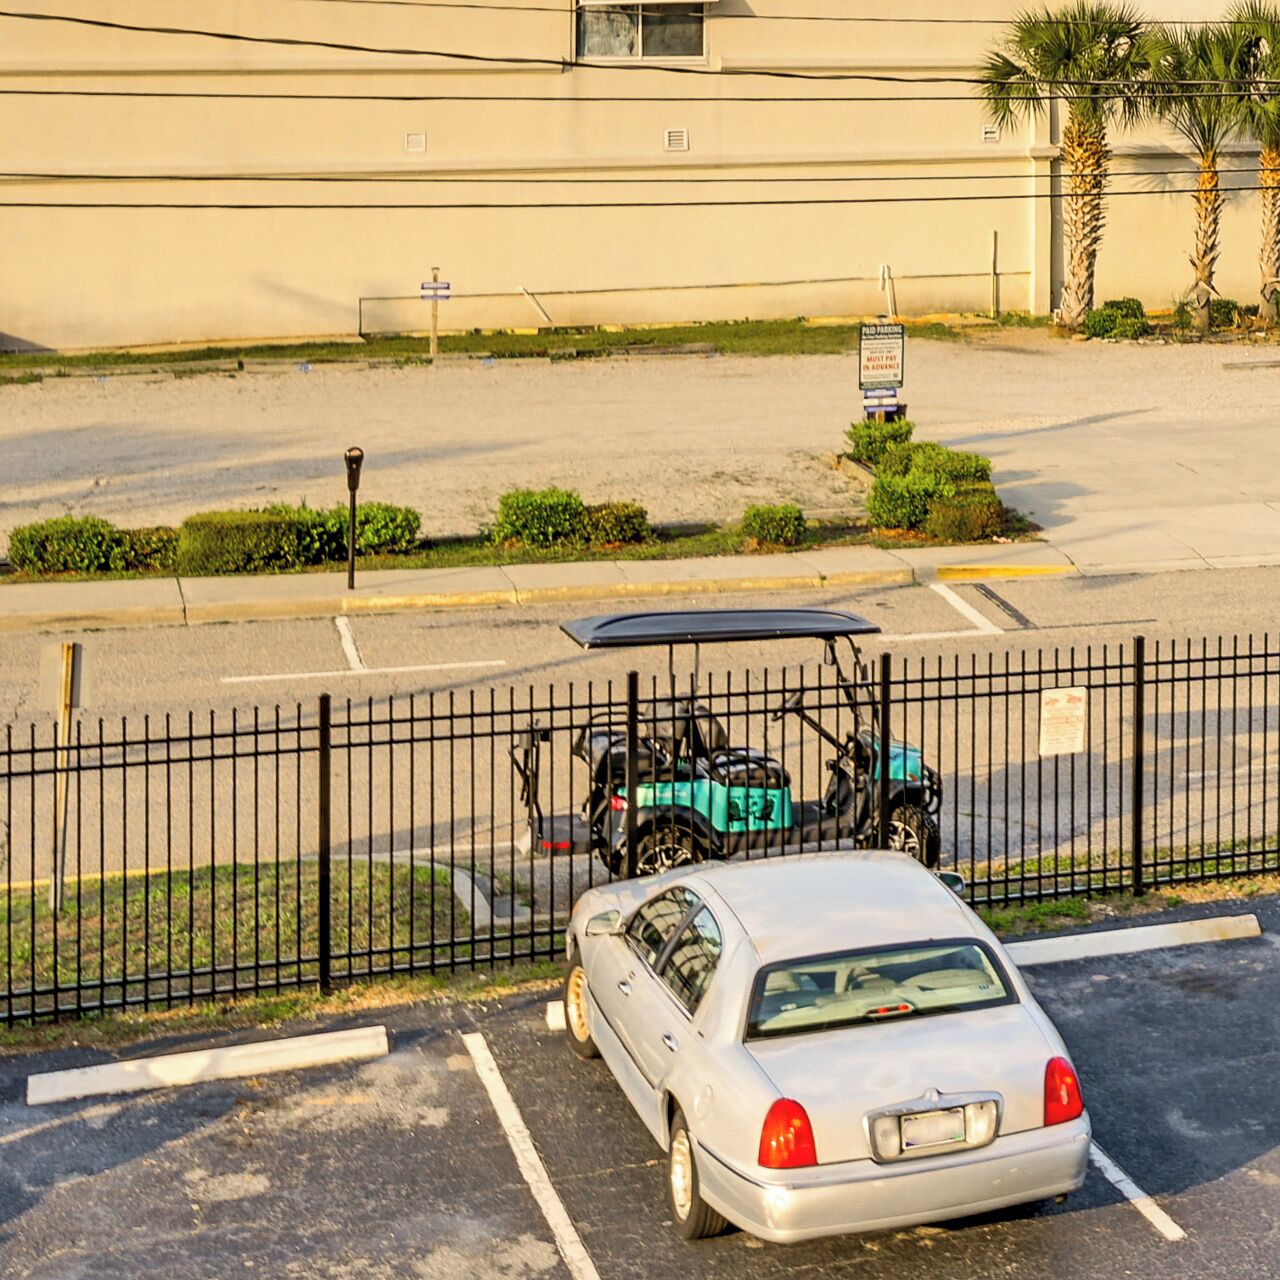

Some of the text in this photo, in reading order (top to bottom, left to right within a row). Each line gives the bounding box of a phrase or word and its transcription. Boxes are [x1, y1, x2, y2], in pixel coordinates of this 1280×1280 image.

[861, 324, 903, 334] PAID PARKING
[866, 354, 897, 363] MUST PAY
[871, 363, 900, 371] ADVANCE
